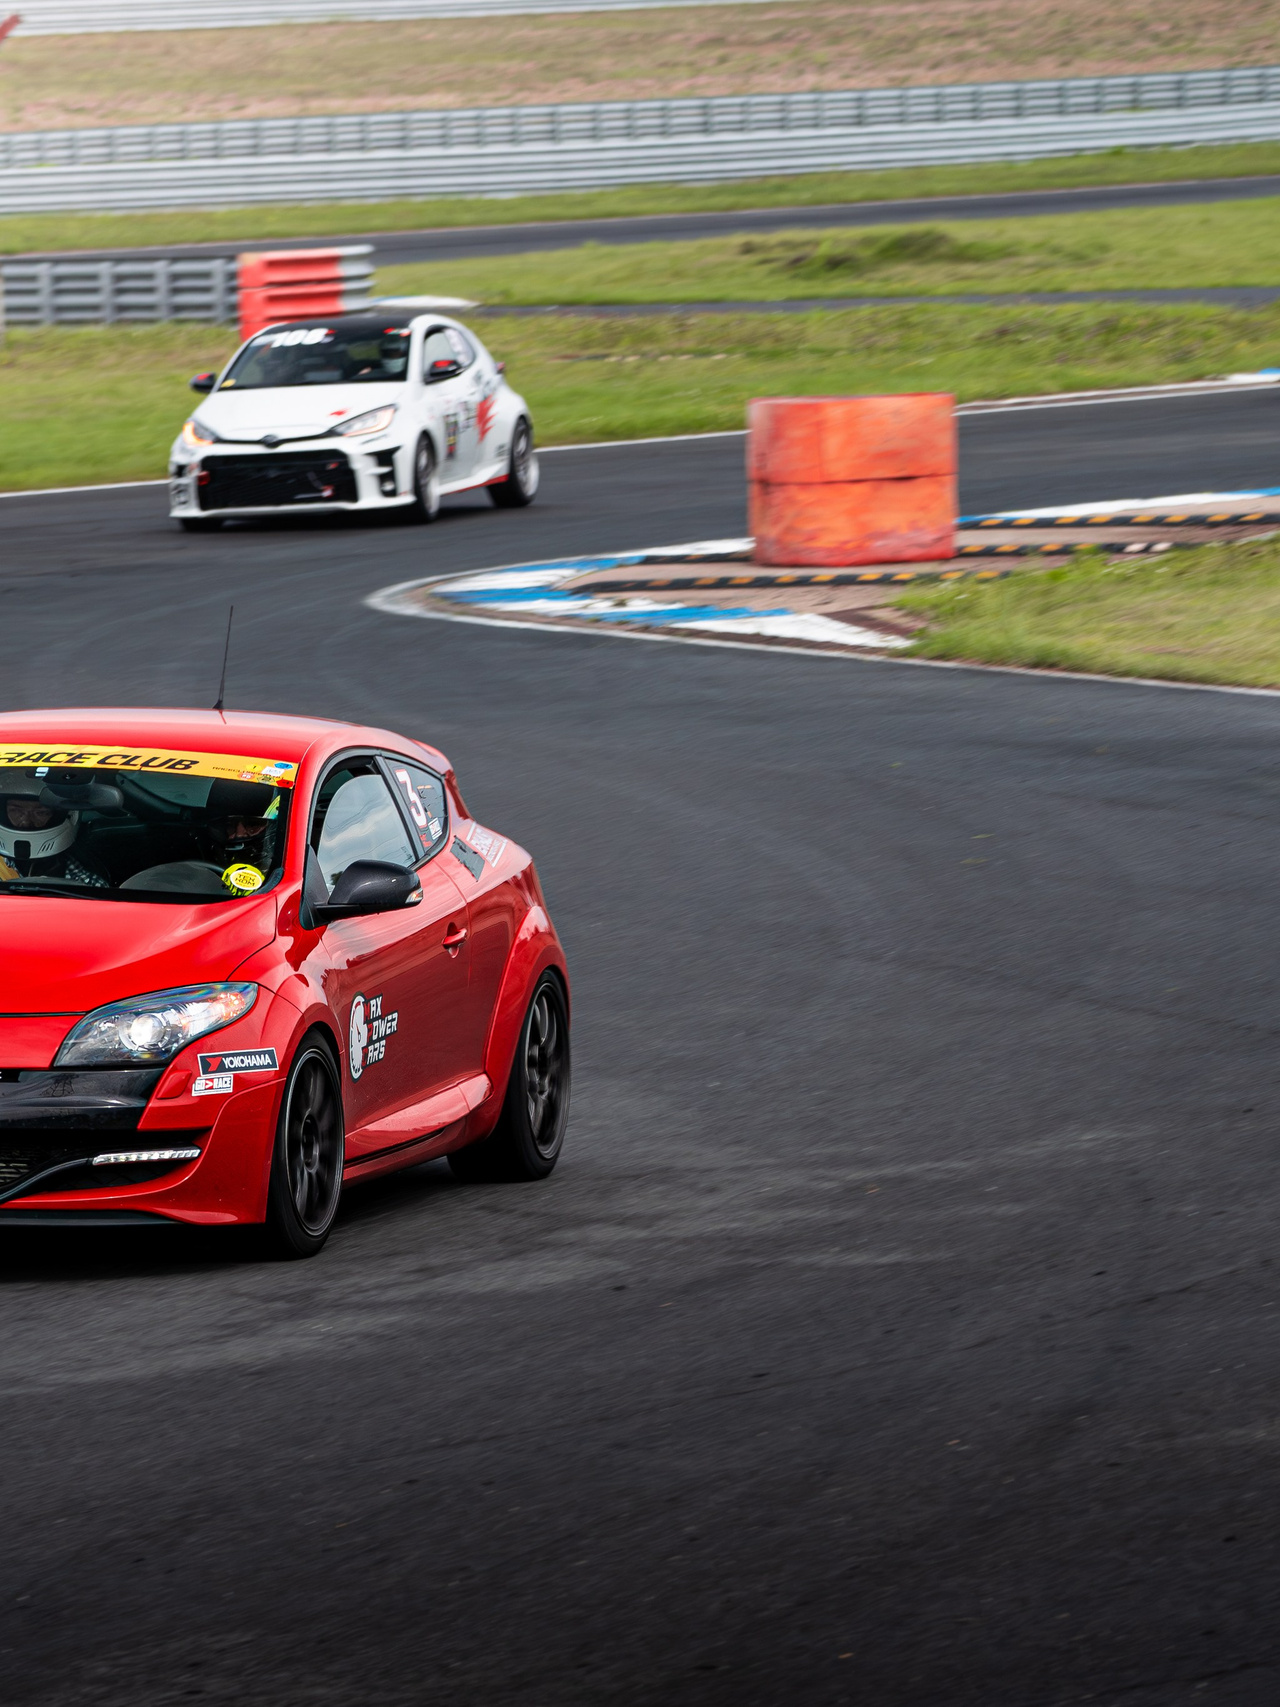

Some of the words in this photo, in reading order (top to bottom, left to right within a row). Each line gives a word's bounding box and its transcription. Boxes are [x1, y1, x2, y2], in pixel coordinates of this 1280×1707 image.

[97, 754, 200, 770] CLUB
[395, 769, 427, 828] 3
[363, 995, 383, 1021] MAX
[366, 1012, 398, 1043] POWER
[222, 1053, 273, 1069] YOKOHAMA
[361, 1039, 386, 1067] CARS
